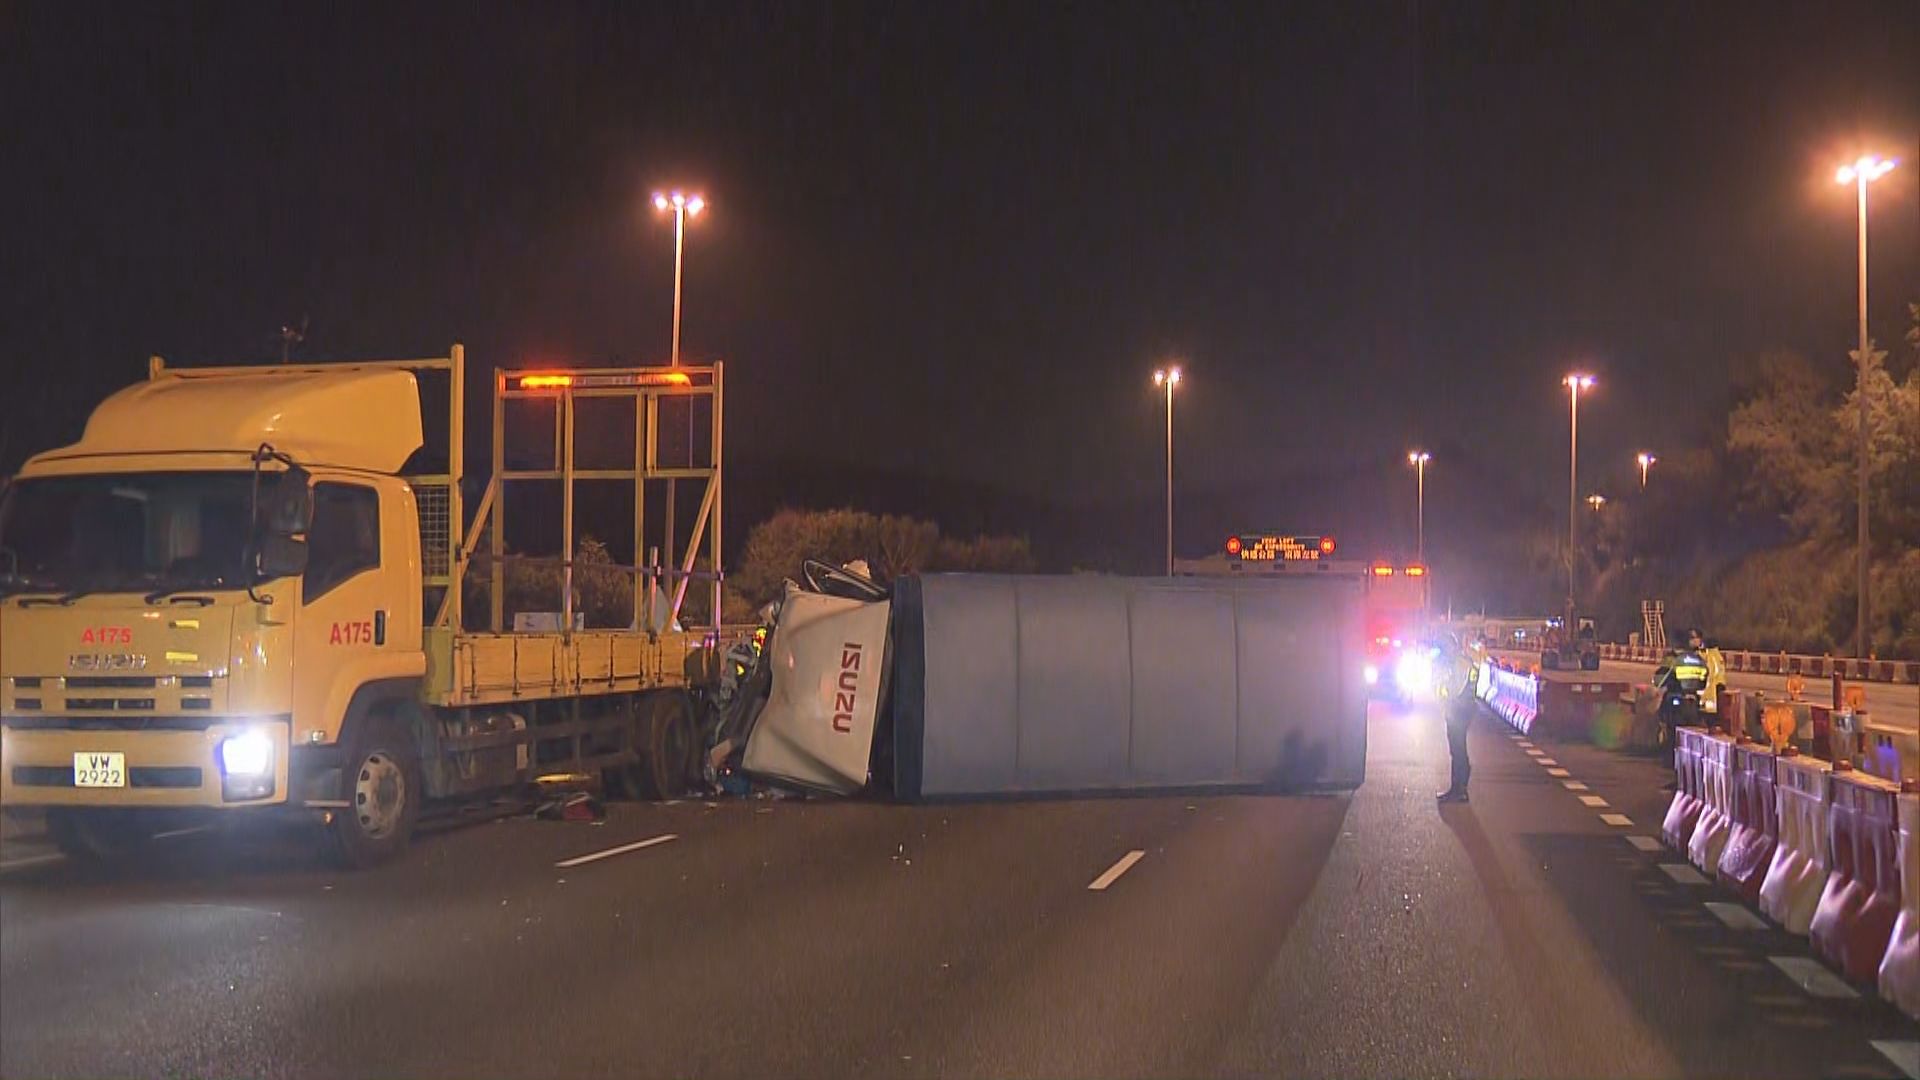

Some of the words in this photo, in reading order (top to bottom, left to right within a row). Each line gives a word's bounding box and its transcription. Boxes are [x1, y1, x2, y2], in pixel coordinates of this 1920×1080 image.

[80, 625, 132, 645] A175
[329, 621, 372, 645] A175
[832, 642, 863, 734] ISUZU
[90, 755, 110, 769] VW
[79, 770, 120, 784] 2922
